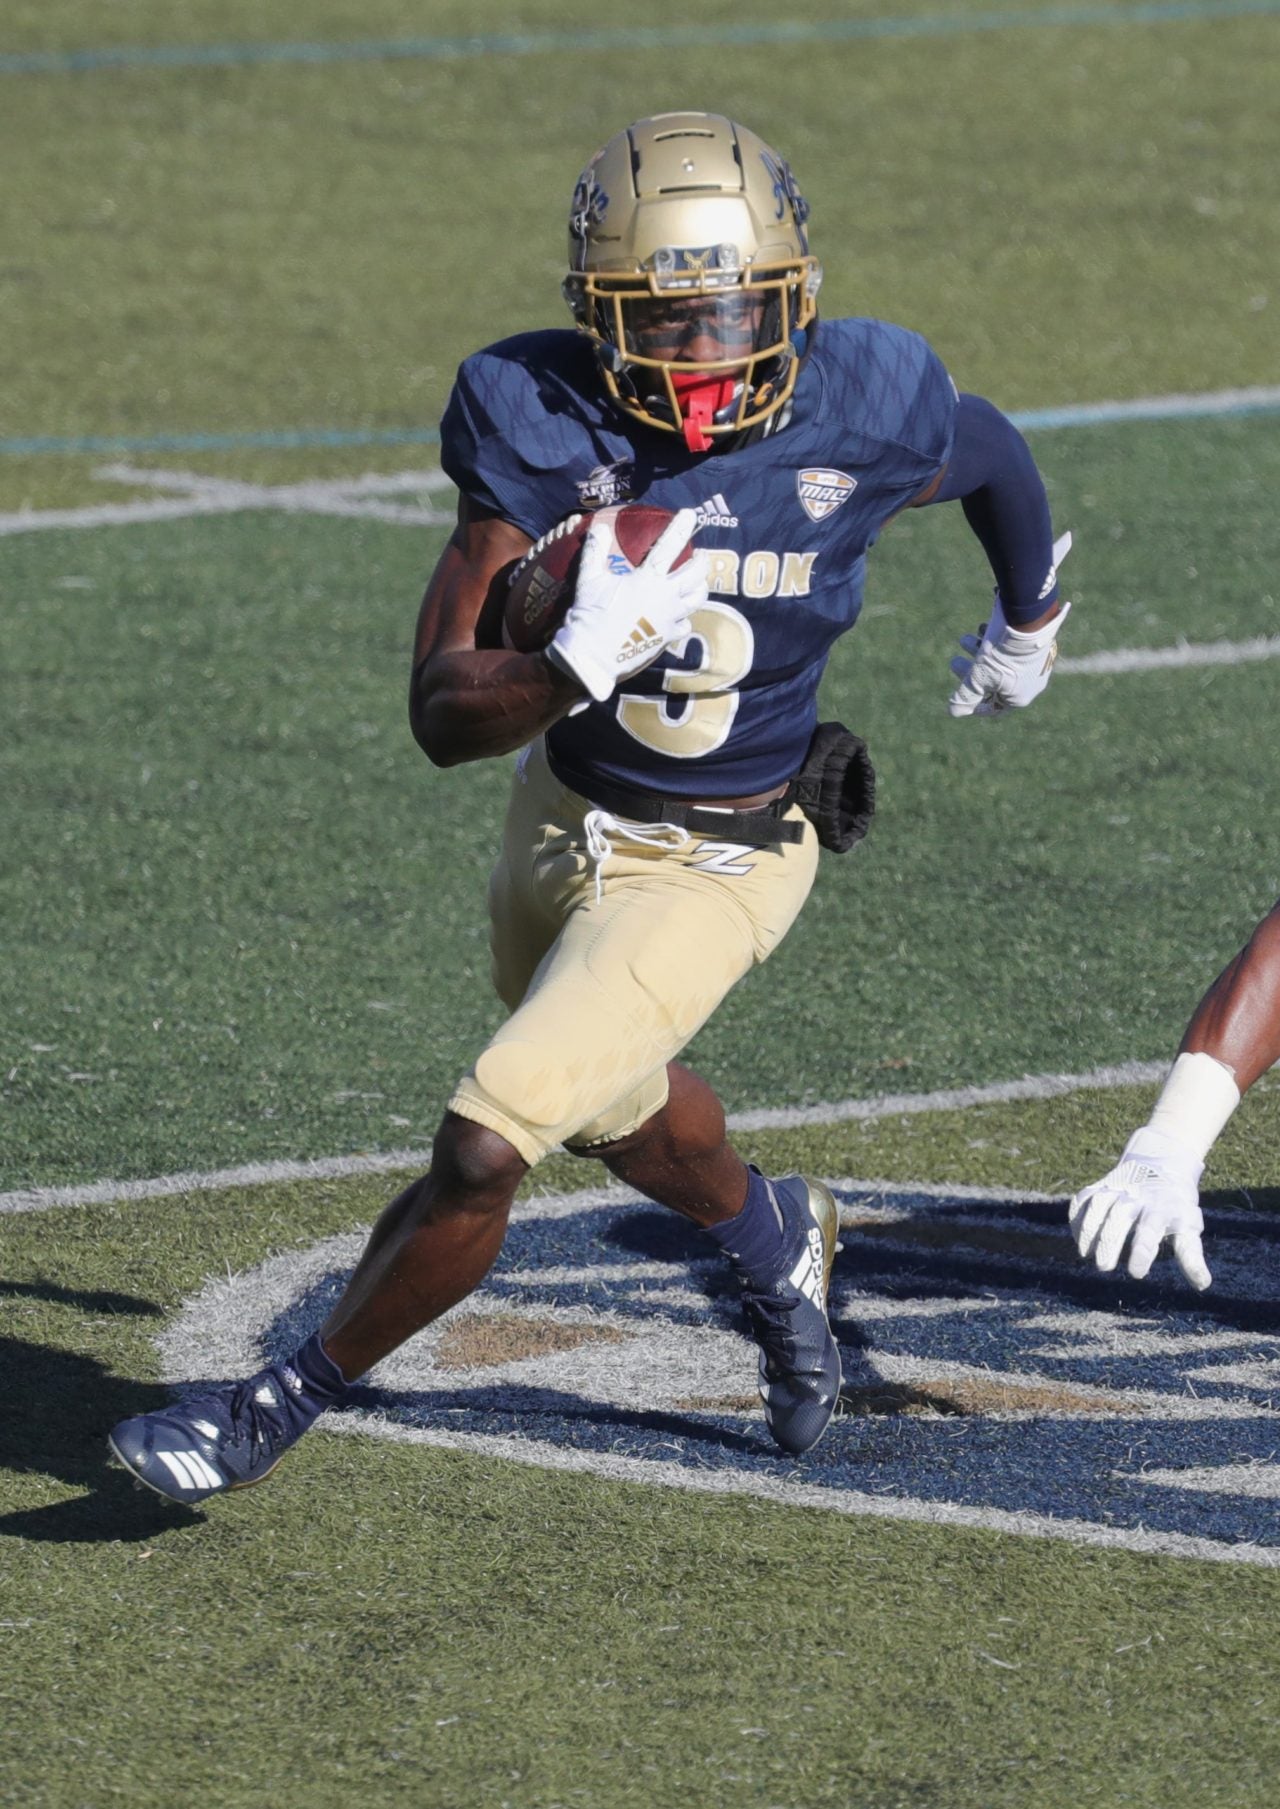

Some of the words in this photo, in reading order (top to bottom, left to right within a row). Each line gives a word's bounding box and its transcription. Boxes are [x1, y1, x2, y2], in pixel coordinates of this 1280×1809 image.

[801, 482, 850, 502] MAC
[697, 513, 739, 528] didas
[706, 548, 820, 599] RON
[616, 635, 664, 664] adidas
[616, 601, 755, 758] 3
